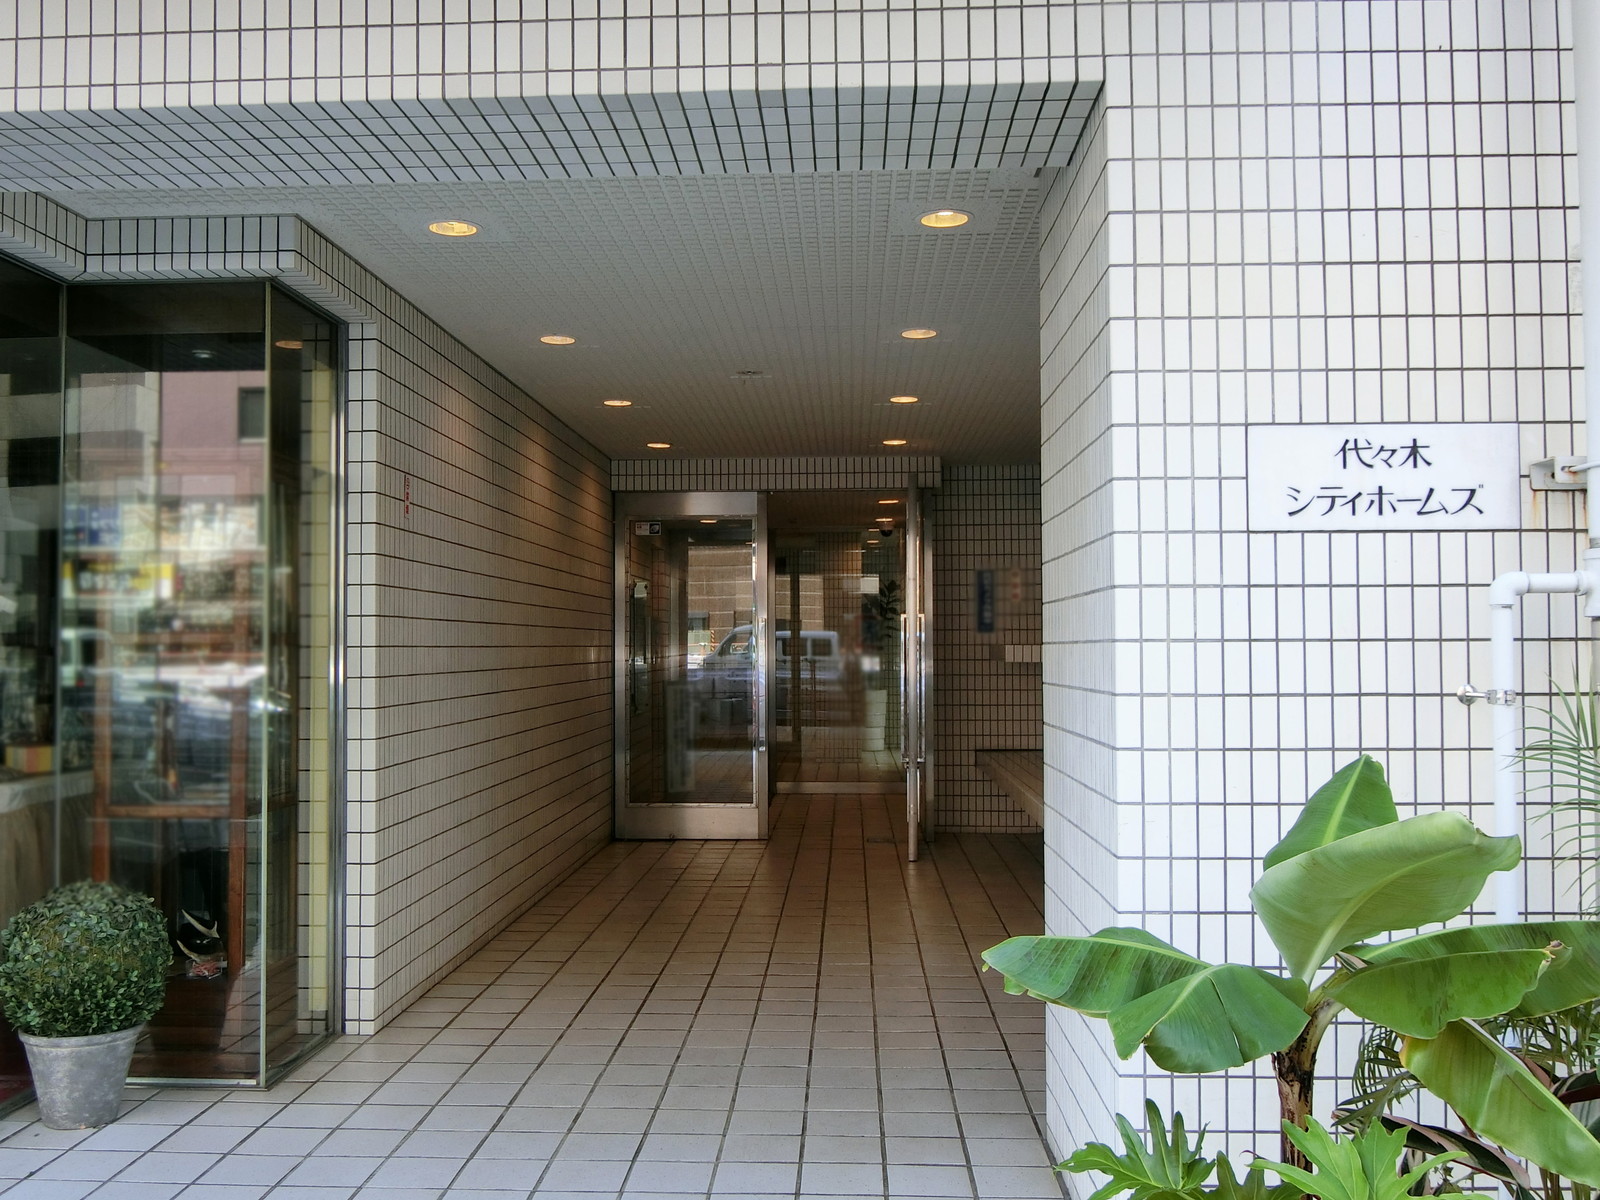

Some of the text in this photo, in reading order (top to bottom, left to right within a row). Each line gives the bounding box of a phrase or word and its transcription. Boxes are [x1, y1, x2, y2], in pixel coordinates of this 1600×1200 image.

[1334, 437, 1433, 470] 代々木
[1286, 484, 1484, 517] シティホームズ
